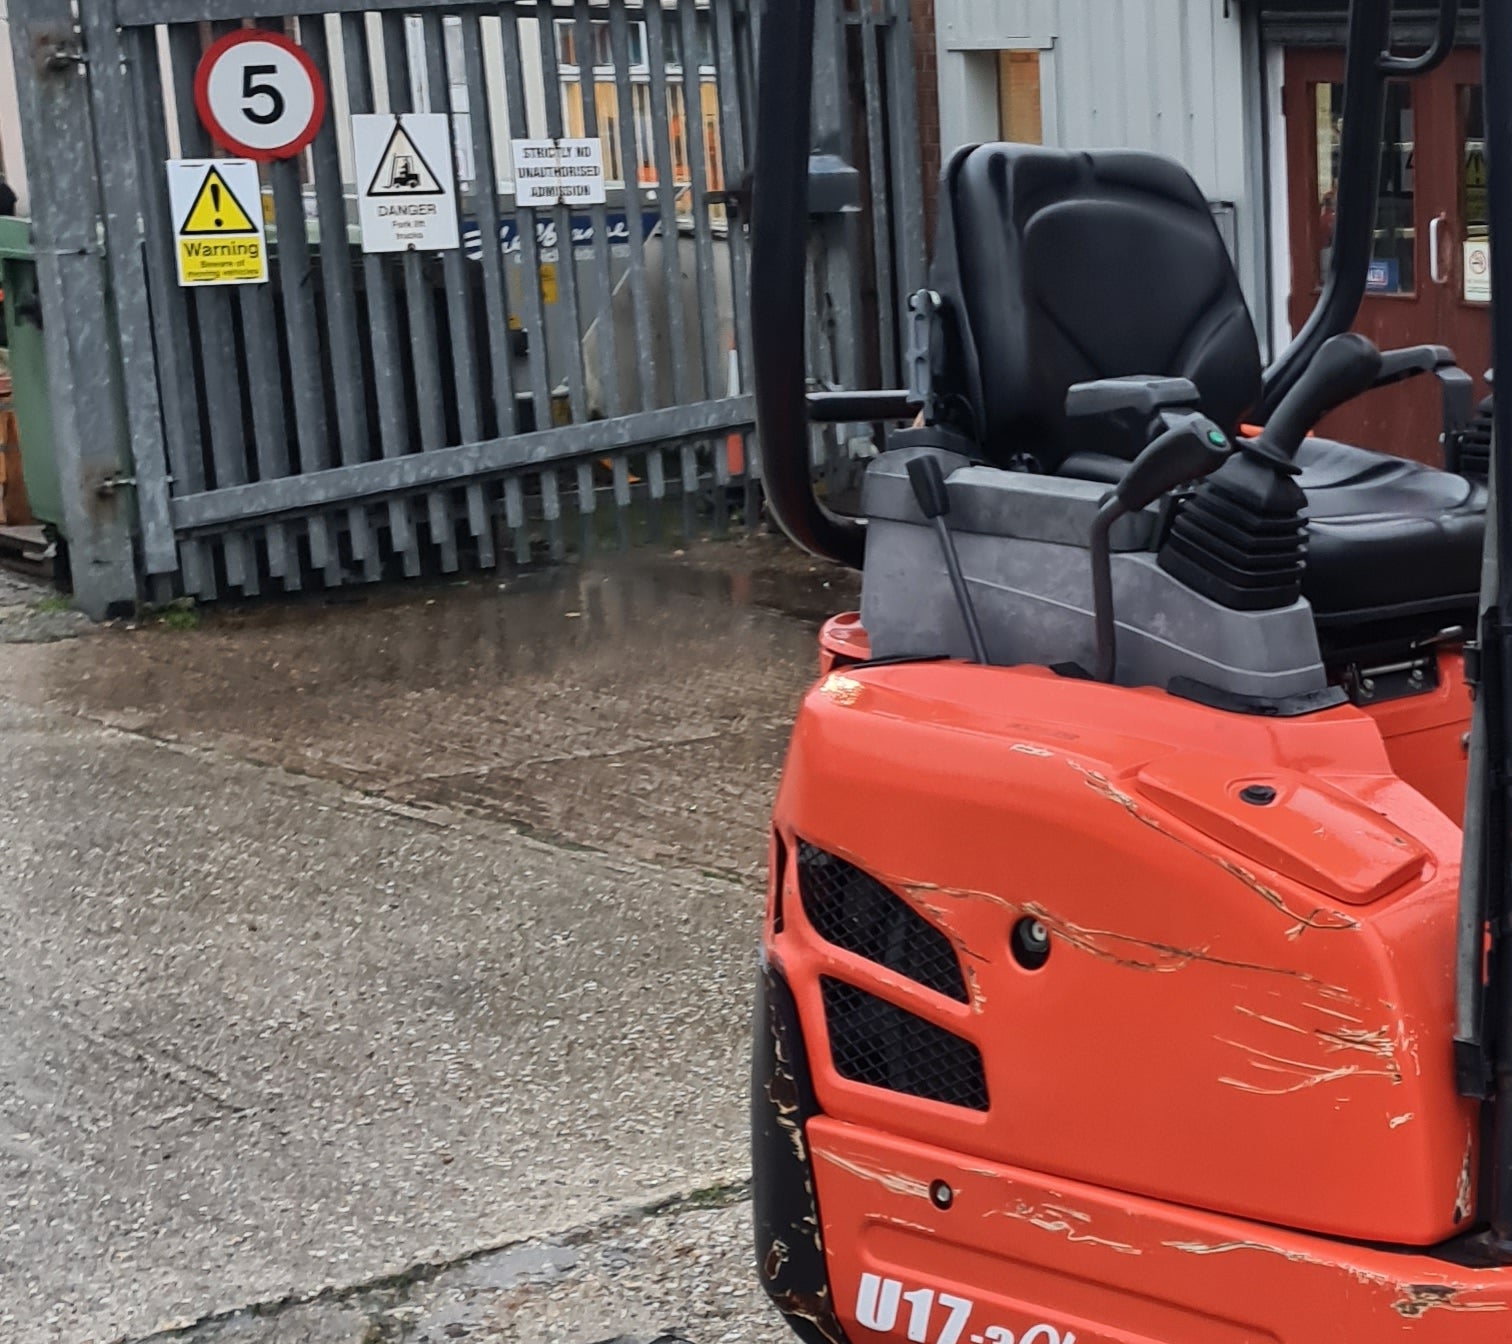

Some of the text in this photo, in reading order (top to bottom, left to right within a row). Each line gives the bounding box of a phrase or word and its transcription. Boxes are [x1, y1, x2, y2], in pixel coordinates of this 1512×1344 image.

[241, 64, 285, 125] 5
[522, 146, 592, 159] STRICTLY NO
[518, 165, 600, 178] UNAUTHORISED
[531, 184, 591, 197] ADMISSION
[378, 204, 437, 217] DANGER
[184, 241, 259, 258] Warning
